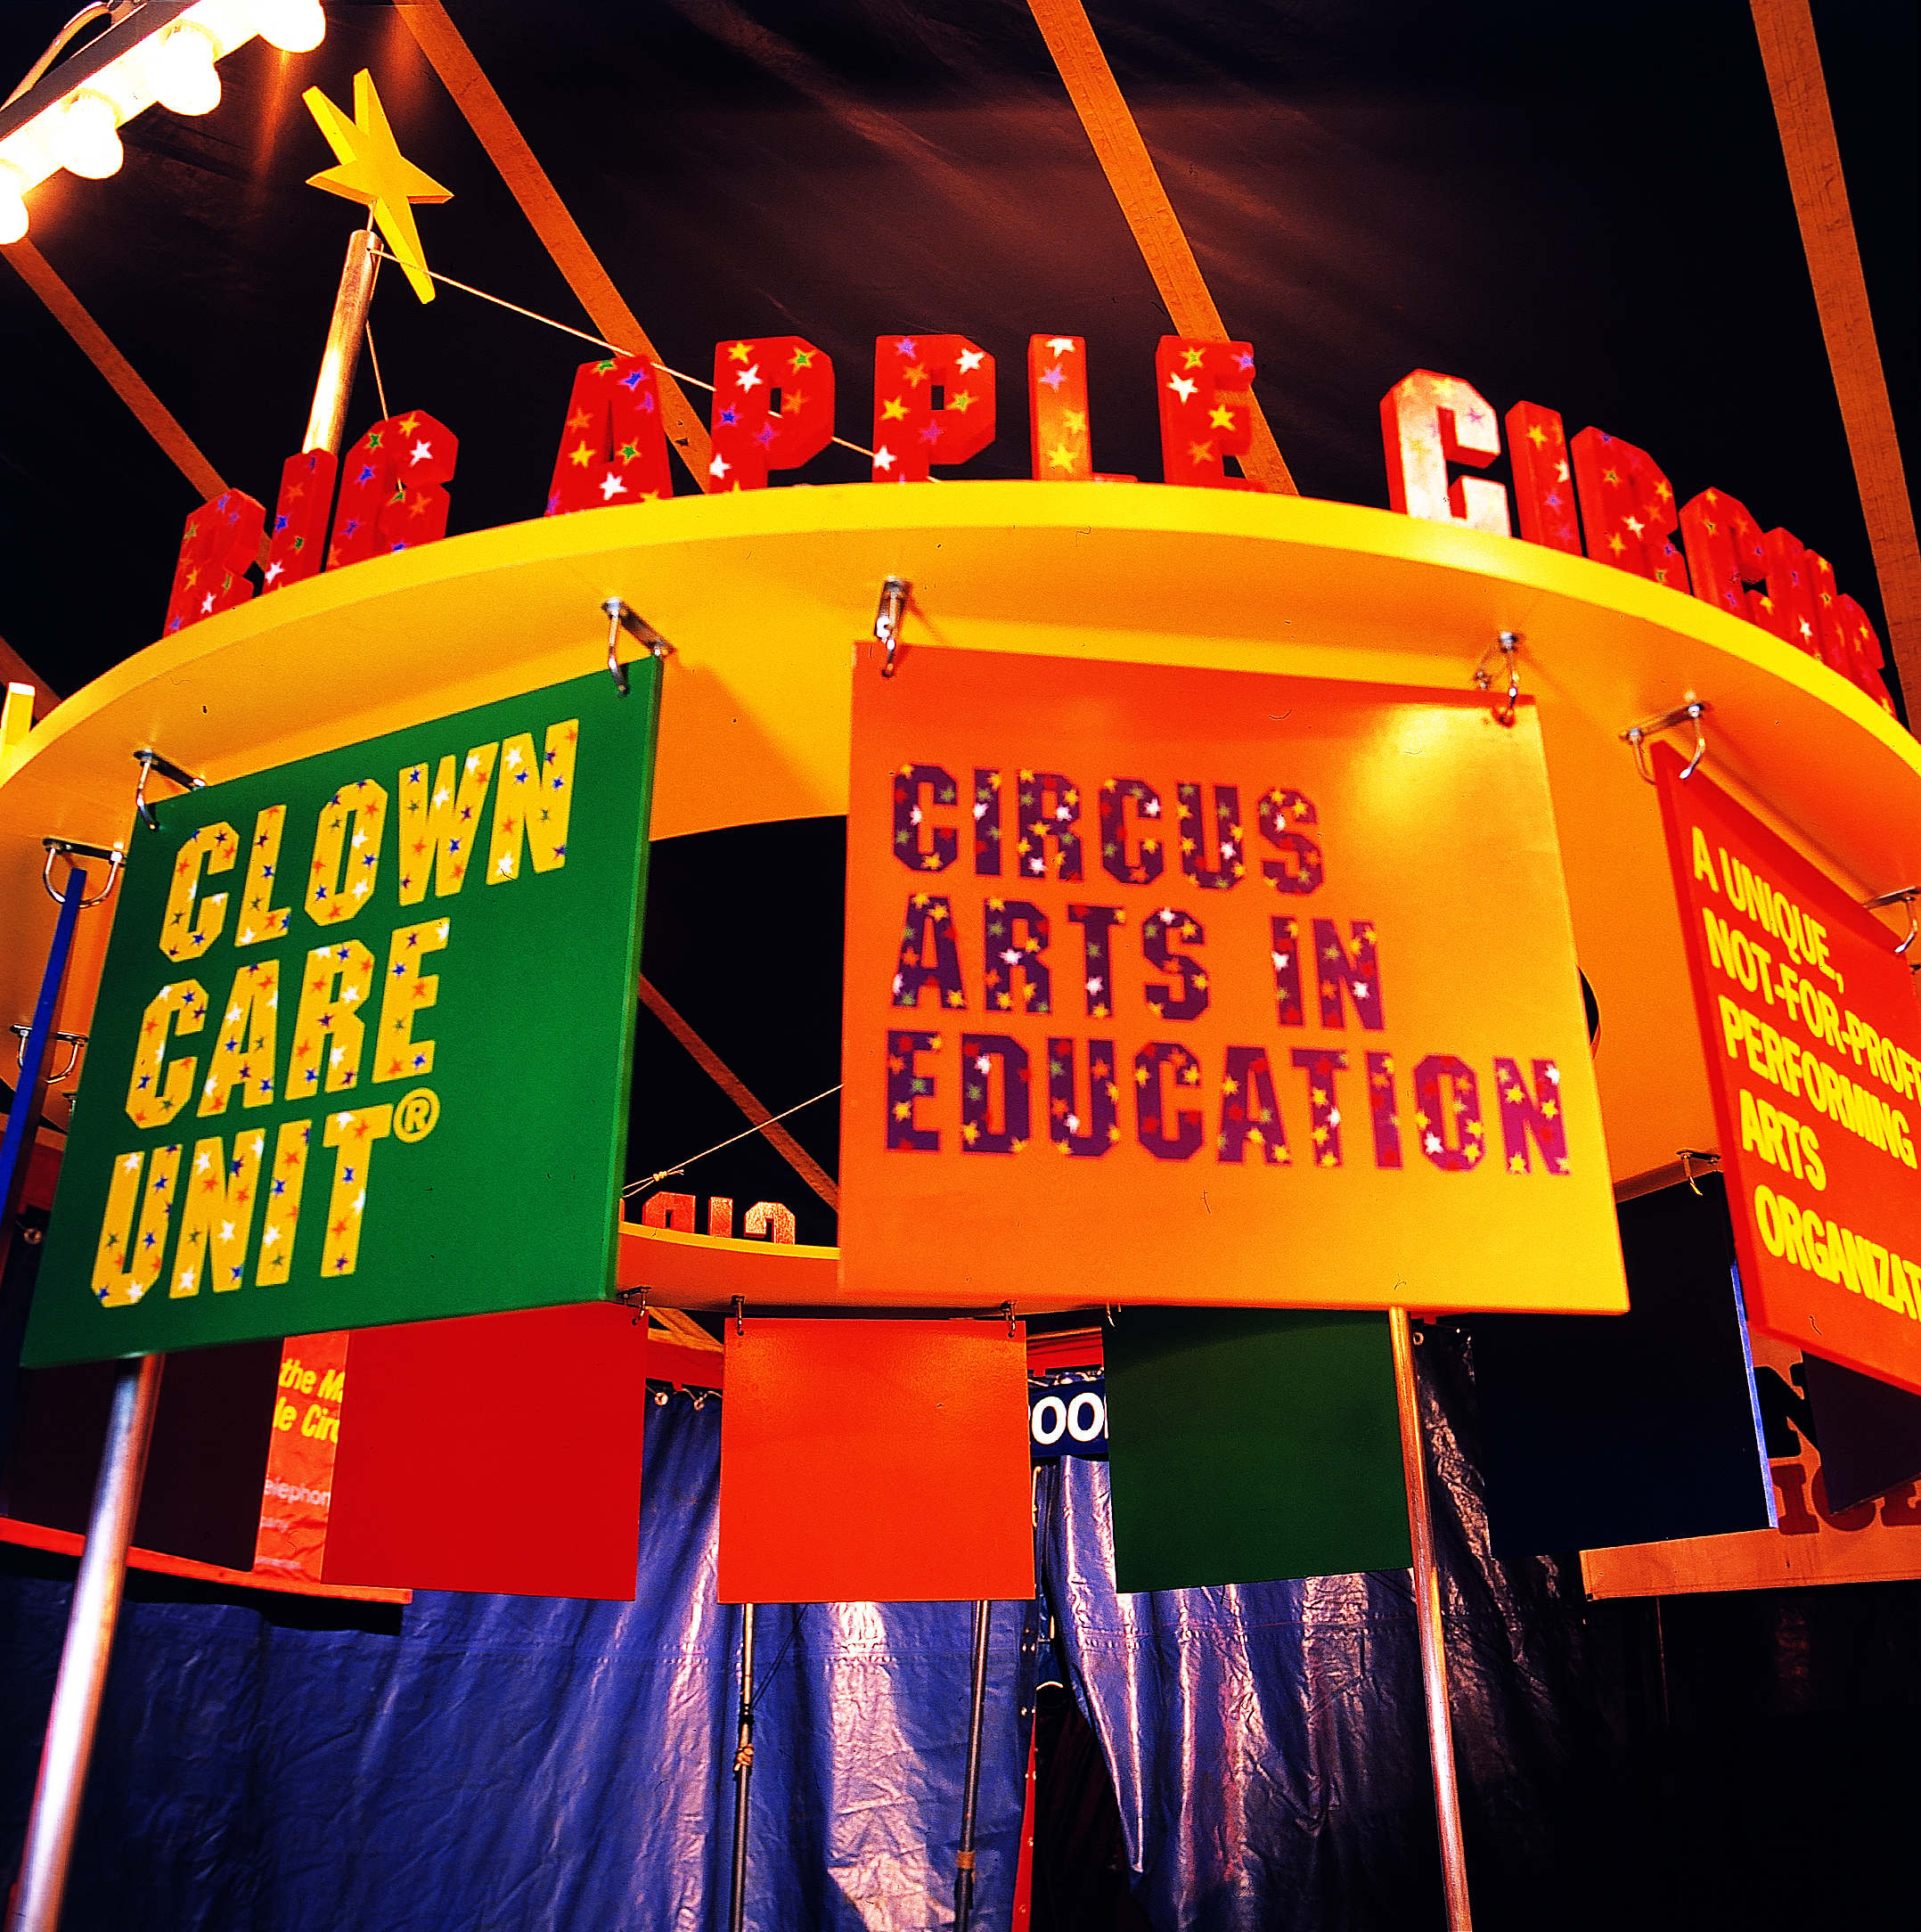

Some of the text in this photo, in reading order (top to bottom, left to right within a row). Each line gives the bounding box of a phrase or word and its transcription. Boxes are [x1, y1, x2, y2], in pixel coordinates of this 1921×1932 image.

[162, 333, 1899, 721] BIG APPLE CIRCUS
[159, 718, 579, 962] CLOWN
[892, 763, 1325, 895] CIRCUS
[891, 893, 1386, 1031] ARTS IN
[1692, 825, 1844, 995] A UNIQUE,
[125, 917, 450, 1129] CARE
[1702, 906, 1921, 1107] NOT-FOR-PROFI
[1718, 994, 1918, 1170] PERFORMING
[887, 1029, 1571, 1175] EDUCATION
[1738, 1087, 1827, 1191] ARTS
[278, 1358, 317, 1395] the
[1028, 1392, 1108, 1445] OO
